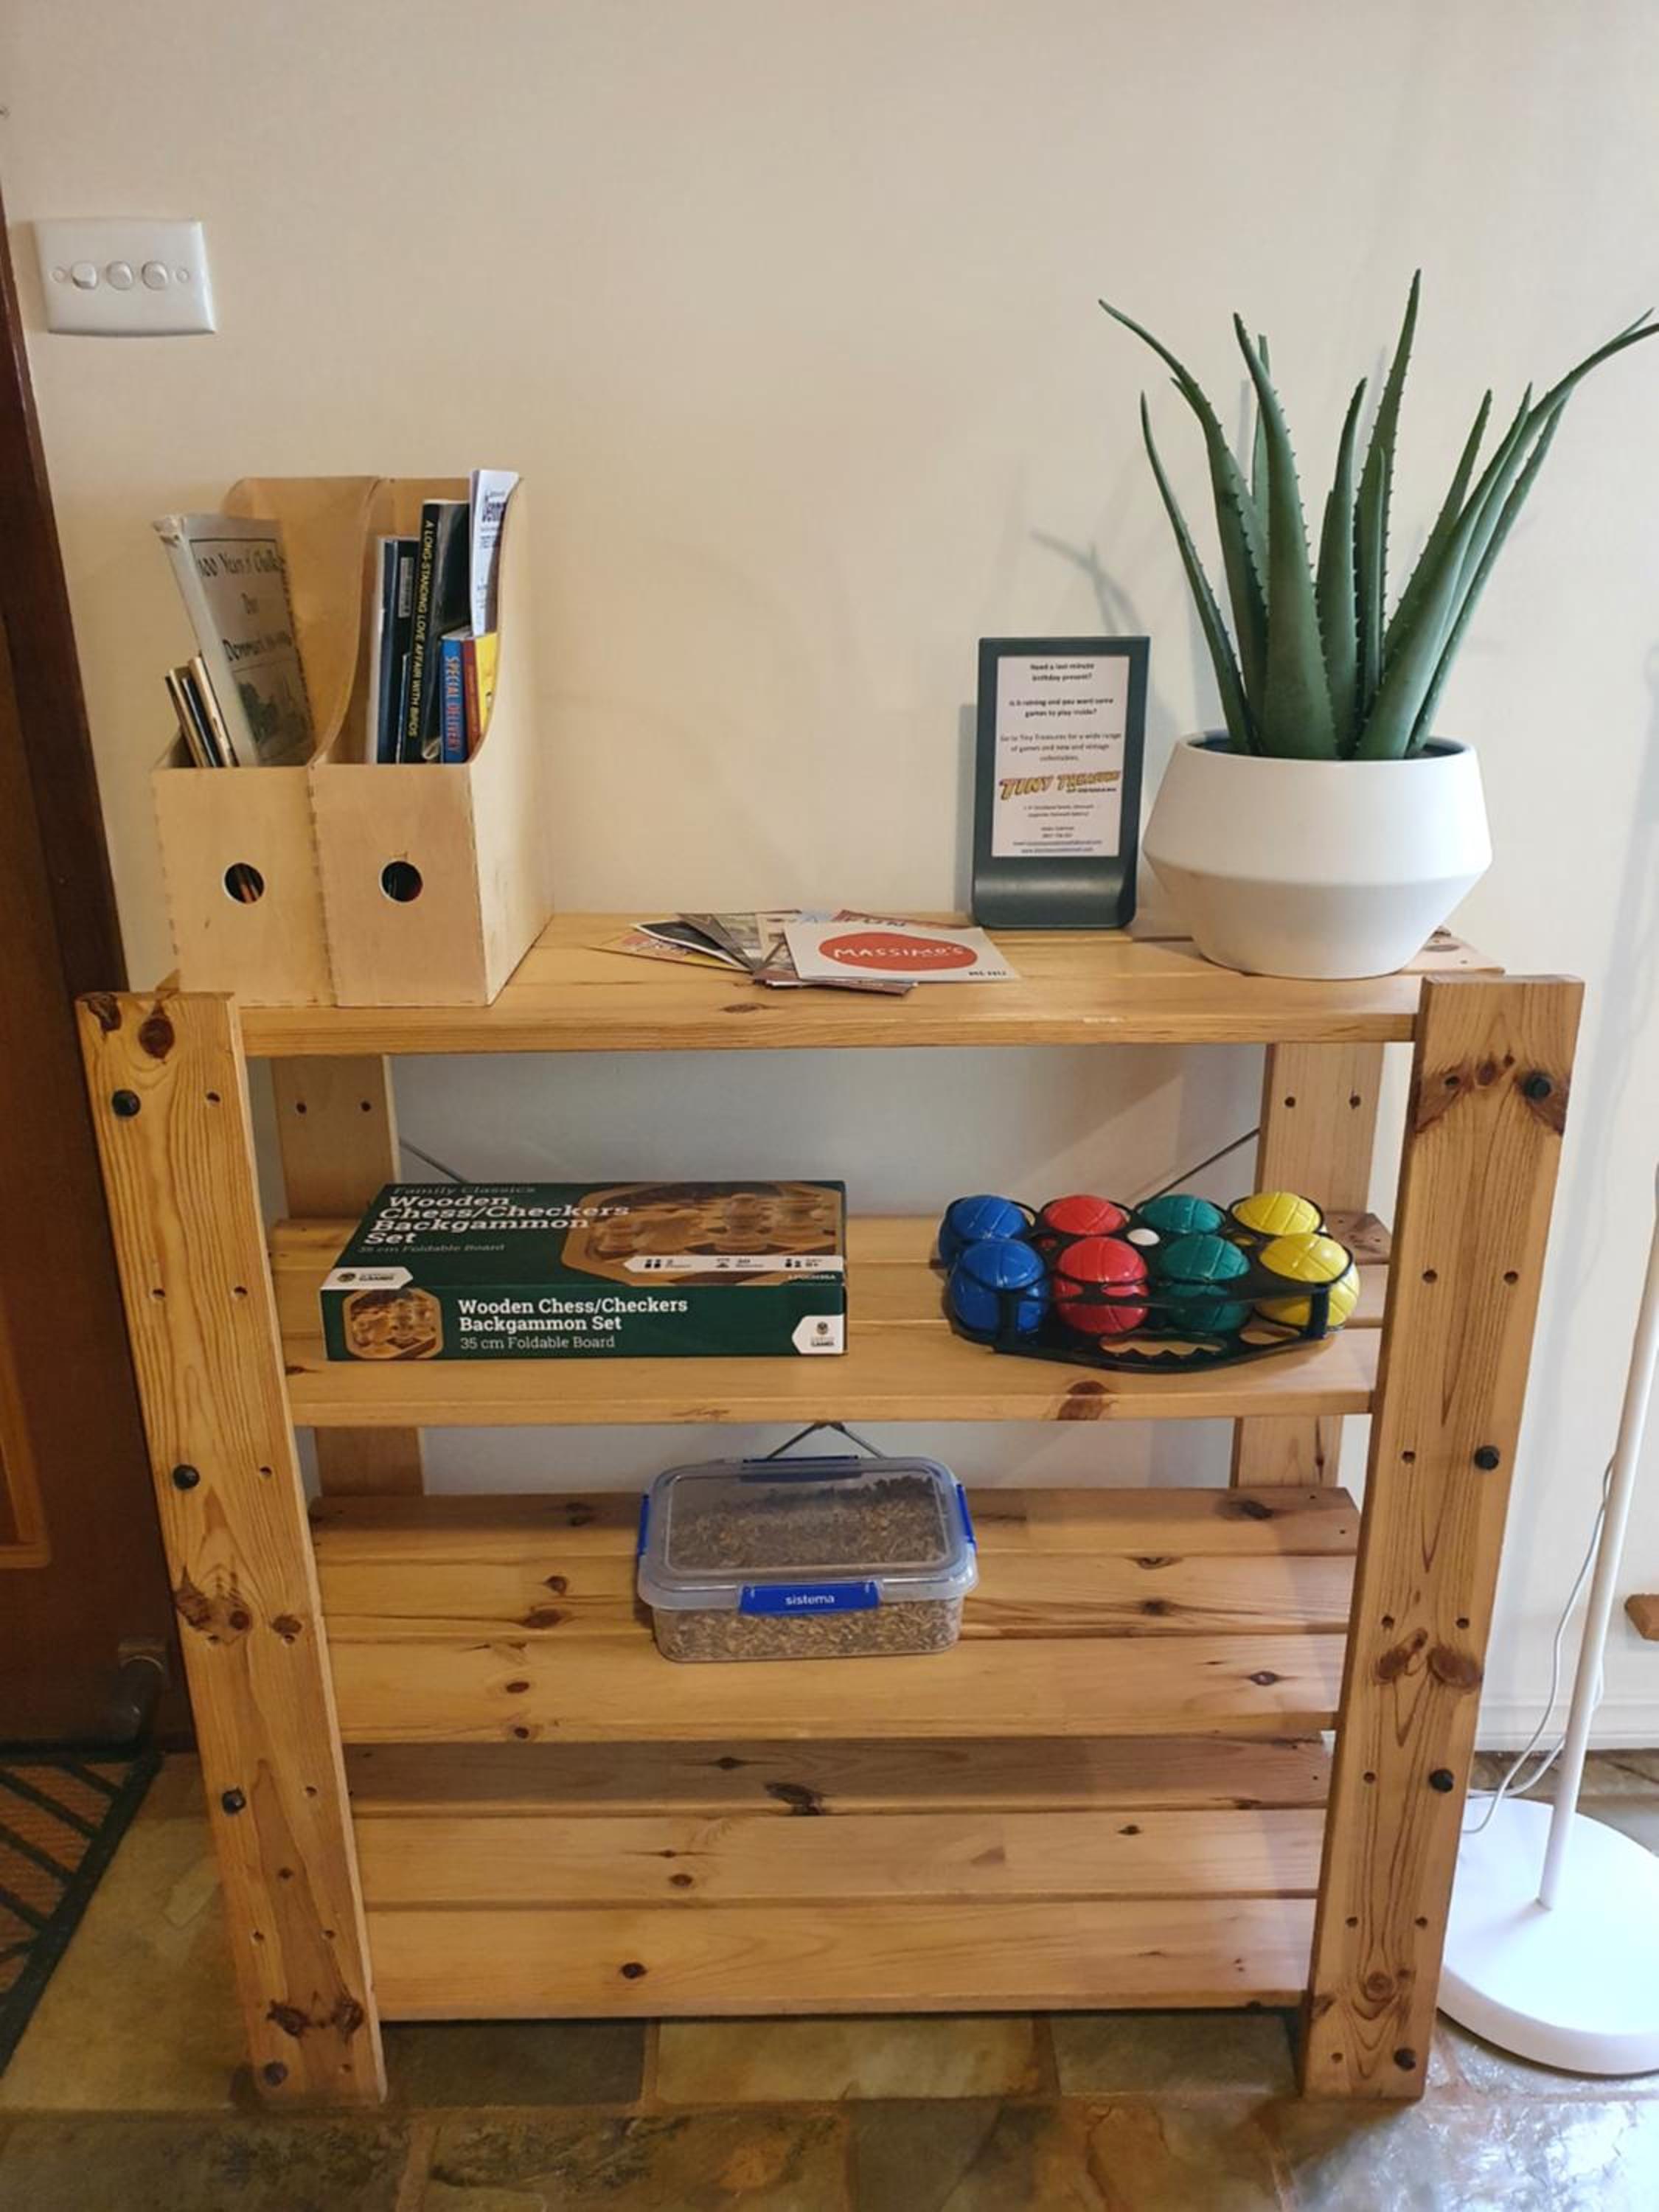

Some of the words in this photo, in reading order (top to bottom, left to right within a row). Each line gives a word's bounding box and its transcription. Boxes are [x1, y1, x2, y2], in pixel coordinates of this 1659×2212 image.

[425, 519, 435, 528] A
[416, 614, 426, 642] LOVE
[412, 642, 425, 678] AFFAIR
[445, 655, 460, 698] SPECIAL
[1032, 674, 1060, 682] birthday
[1062, 672, 1092, 681] present?
[411, 678, 422, 706] WITH
[999, 775, 1054, 800] TINY
[833, 946, 964, 959] MASSIMO'S
[393, 1186, 455, 1196] Family
[461, 1186, 536, 1194] Classics
[389, 1195, 509, 1208] Wooden
[378, 1205, 630, 1220] Chess/Checkers
[371, 1217, 590, 1234] Backgammon
[364, 1232, 417, 1245] Set
[402, 1244, 461, 1253] Foldable
[464, 1243, 505, 1251] Board
[458, 1298, 535, 1314] Wooden
[538, 1295, 688, 1315] Chess/Checkers
[459, 1315, 588, 1335] Backgammon
[592, 1315, 622, 1331] Set
[460, 1337, 478, 1349] 35
[481, 1339, 504, 1349] cm
[508, 1335, 569, 1349] Foldable
[573, 1335, 616, 1349] Board
[785, 1593, 835, 1605] sistema
